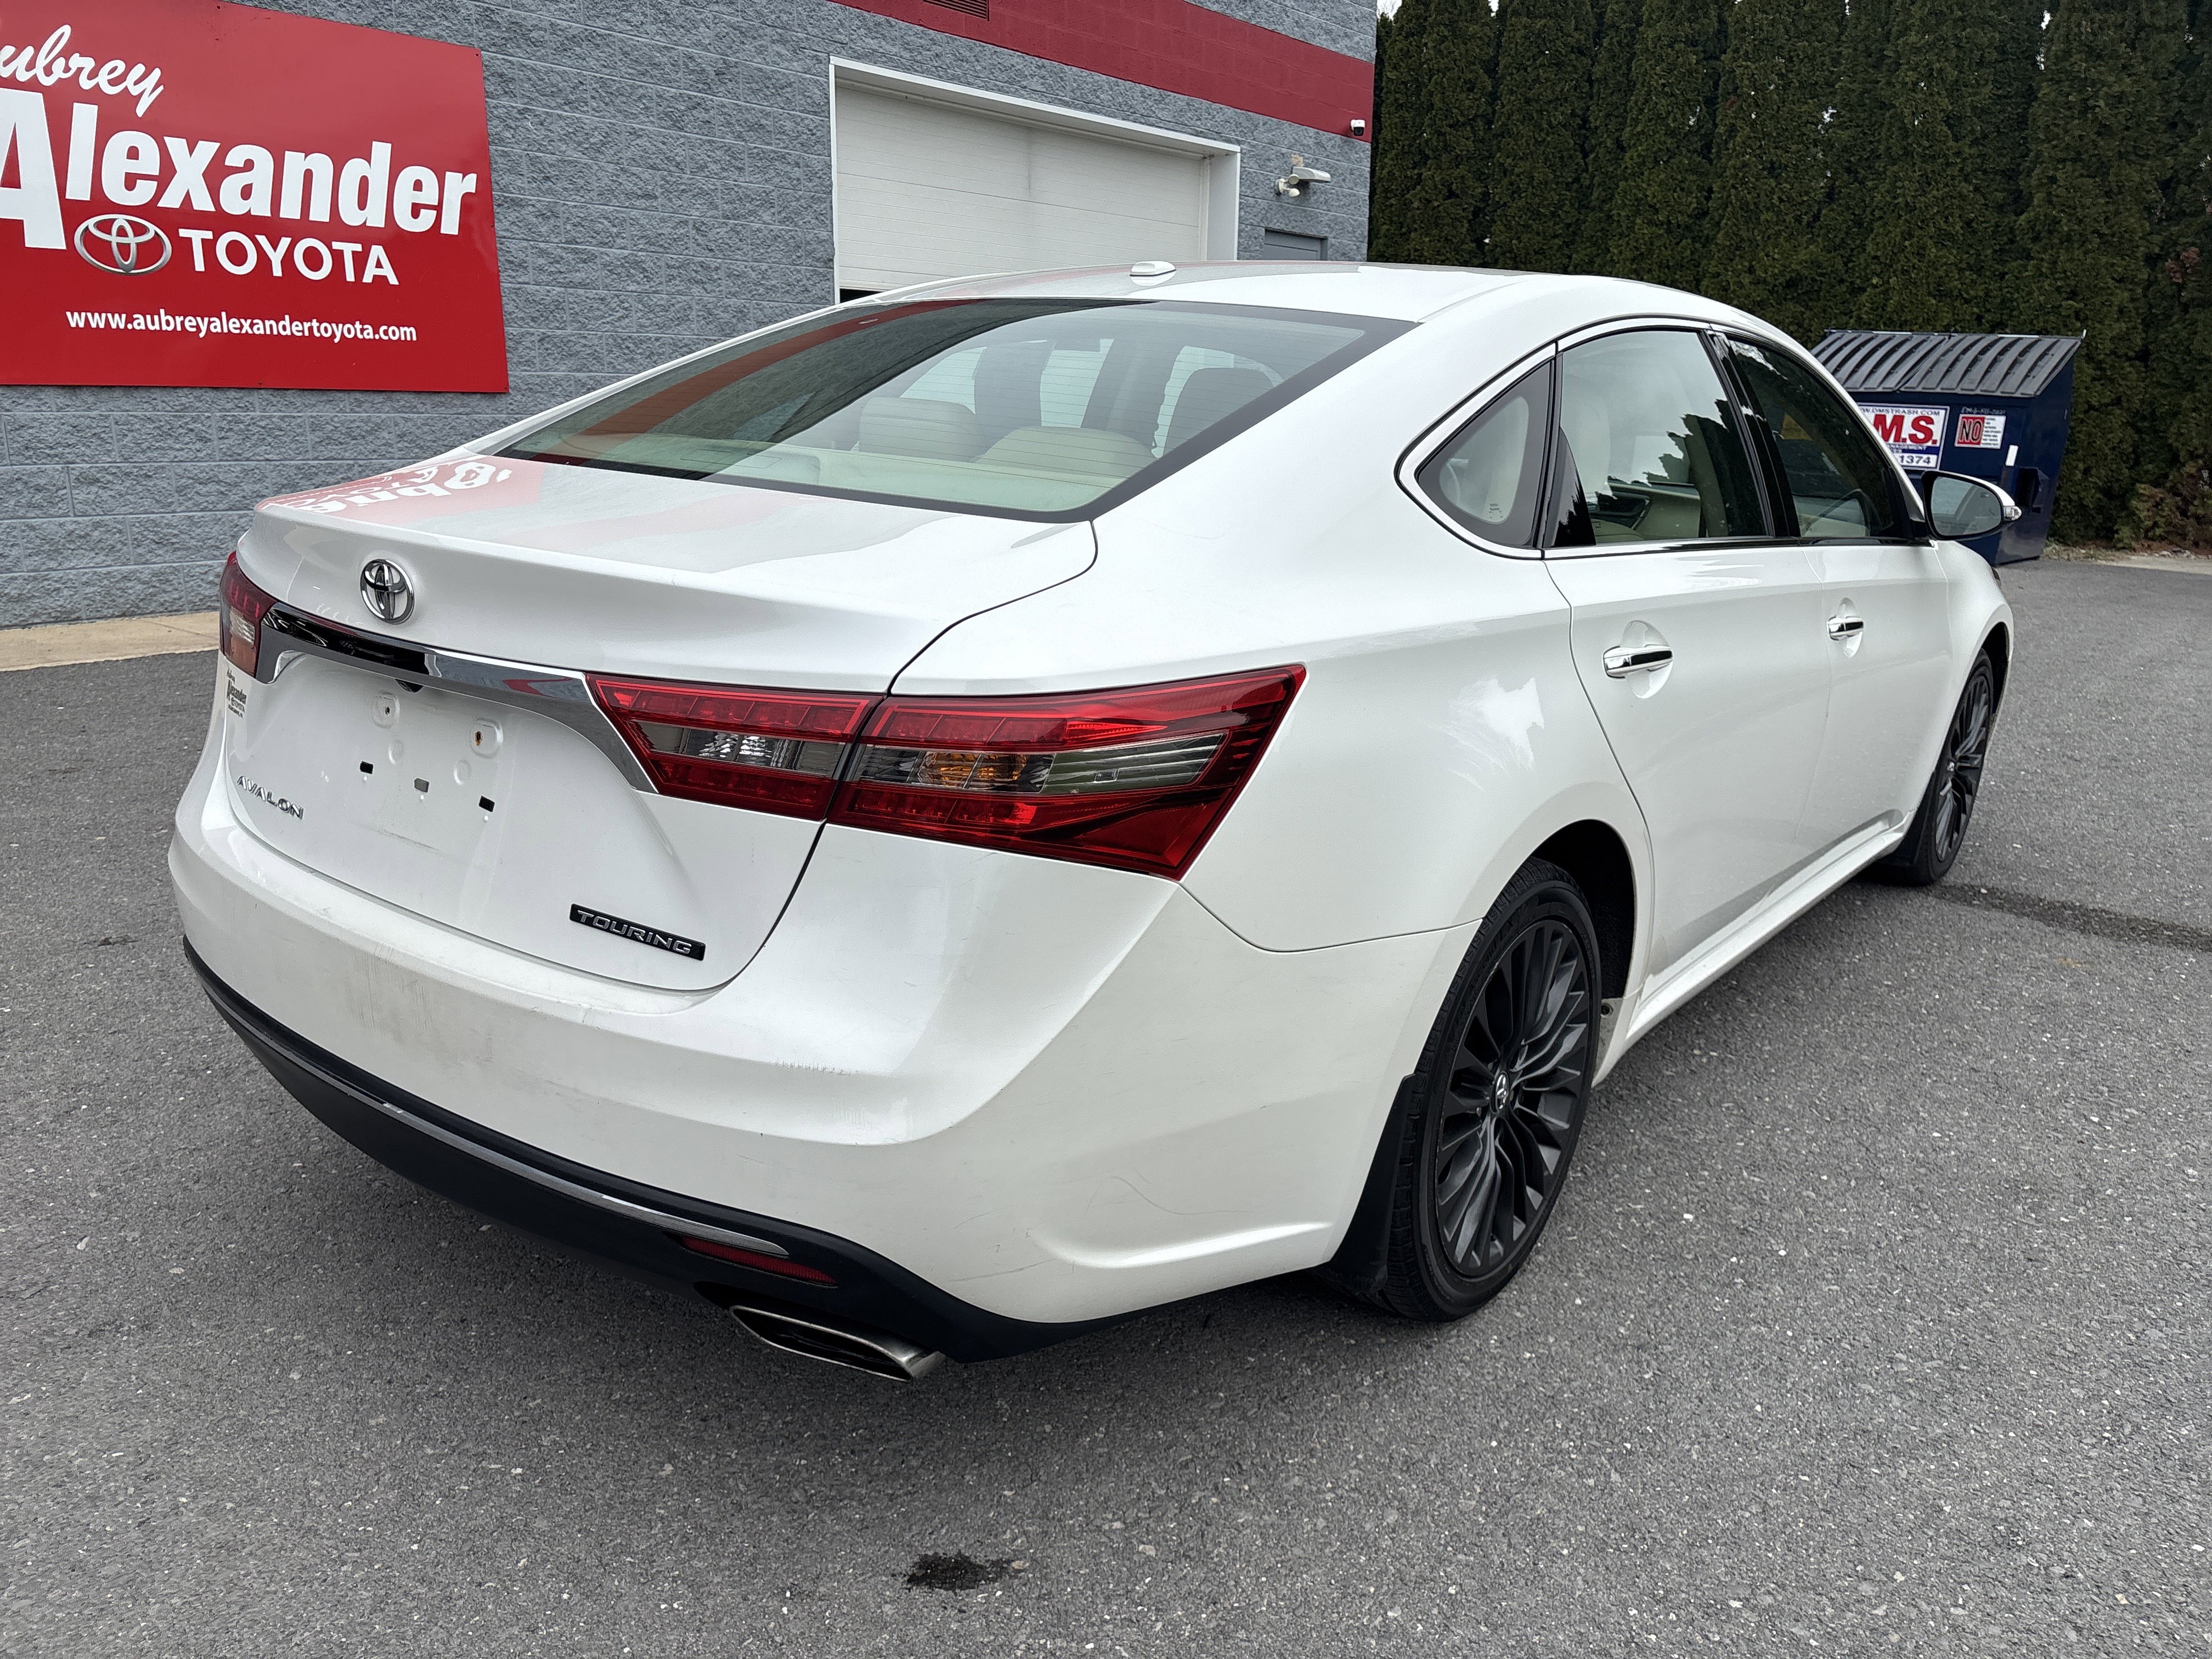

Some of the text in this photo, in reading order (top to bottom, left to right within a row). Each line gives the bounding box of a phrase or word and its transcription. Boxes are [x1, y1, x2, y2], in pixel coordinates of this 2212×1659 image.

[0, 24, 163, 117] ubrey
[0, 87, 477, 250] Alexander
[179, 229, 399, 285] TOYOTA
[66, 309, 417, 343] www.aubreyalexandertoyota.com
[1959, 419, 1983, 443] NO
[236, 775, 304, 820] AVALON
[577, 910, 692, 954] TOURING
